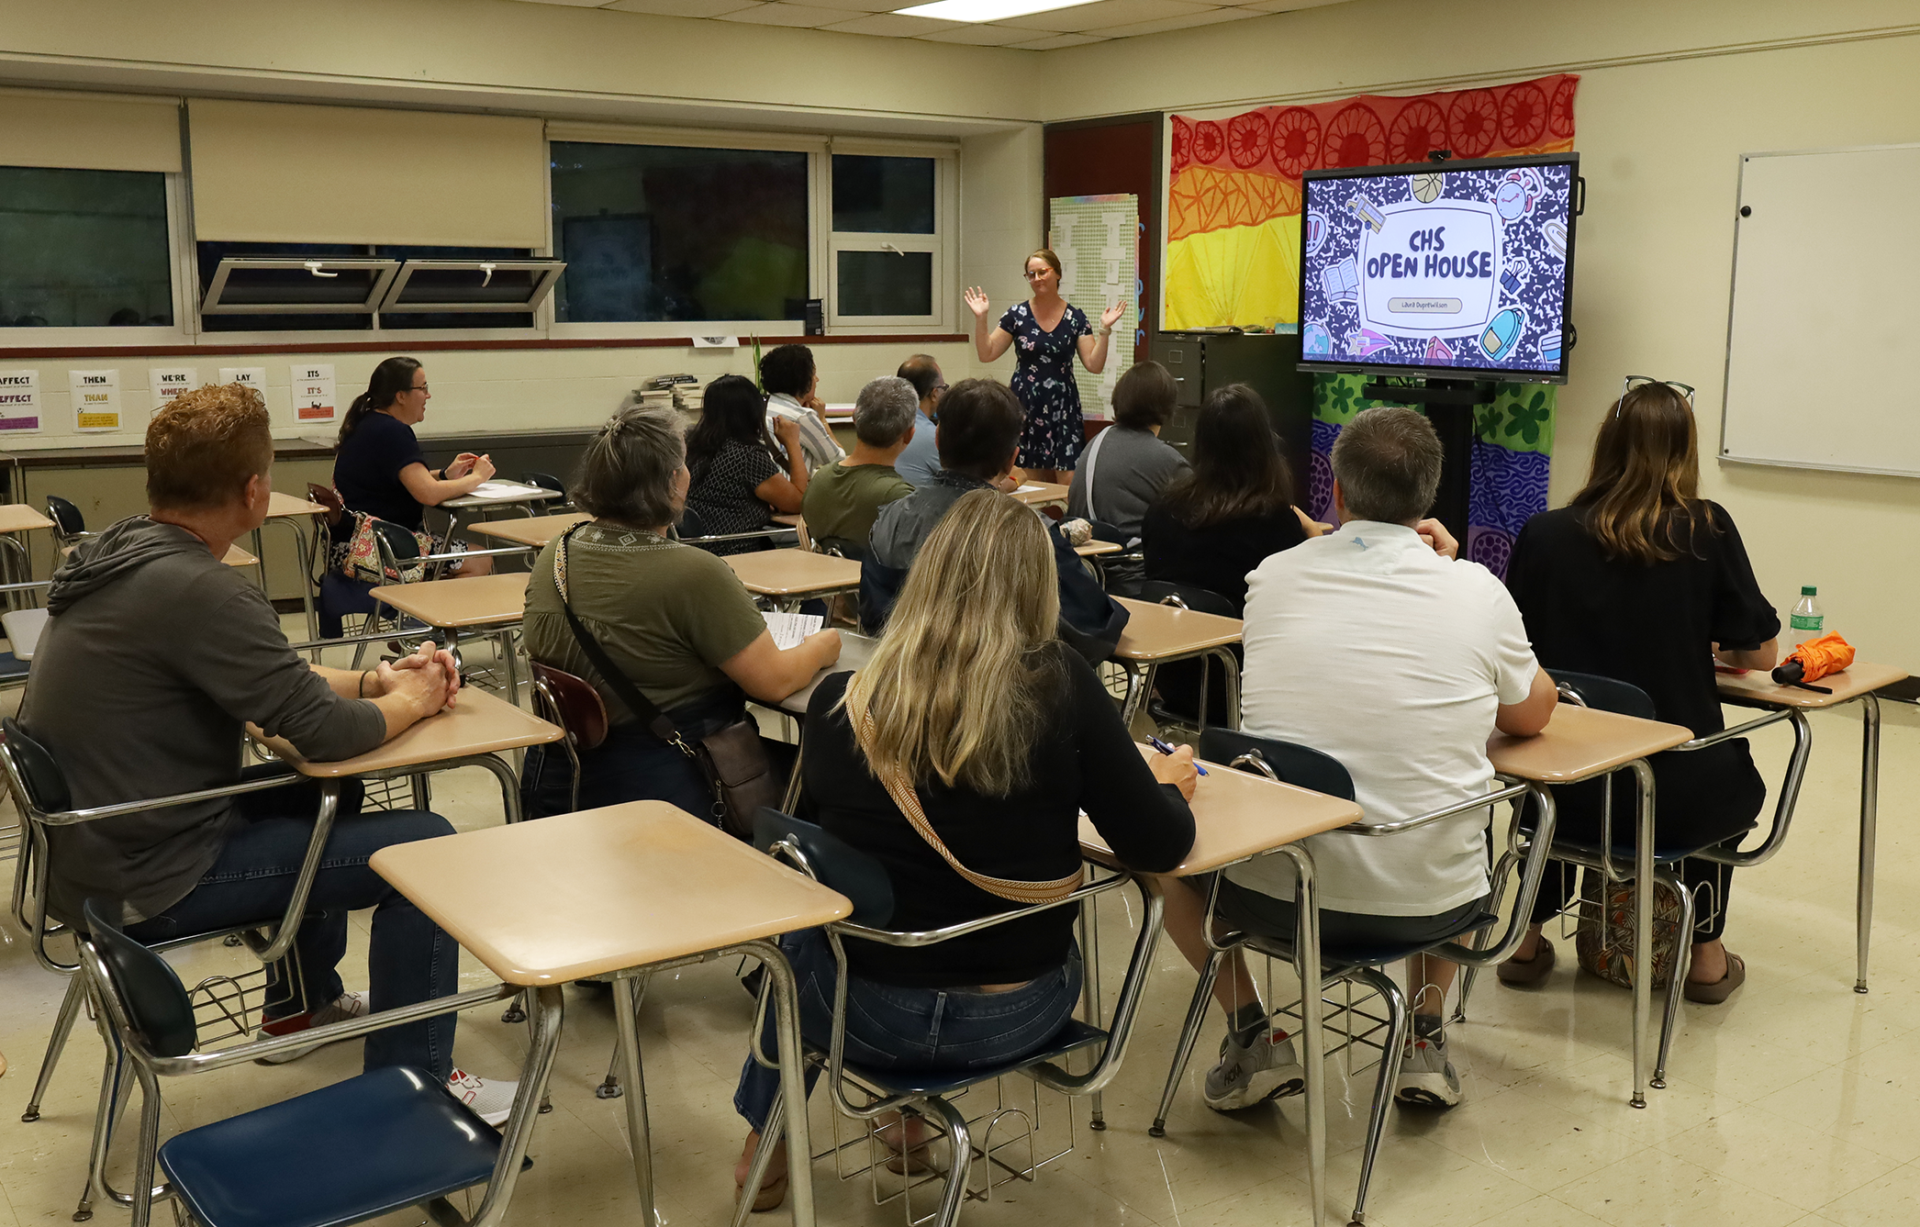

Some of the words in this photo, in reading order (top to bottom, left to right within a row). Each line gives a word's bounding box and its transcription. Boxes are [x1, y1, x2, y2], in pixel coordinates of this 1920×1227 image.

[1409, 226, 1446, 252] CHS
[1367, 252, 1418, 278] OPEN
[1424, 250, 1492, 278] HOUSE
[161, 374, 186, 382] WE'RE
[236, 373, 251, 381] LAY
[307, 370, 320, 378] ITS
[83, 376, 106, 384] THEN
[307, 386, 322, 394] IT'S
[84, 393, 108, 402] THAN
